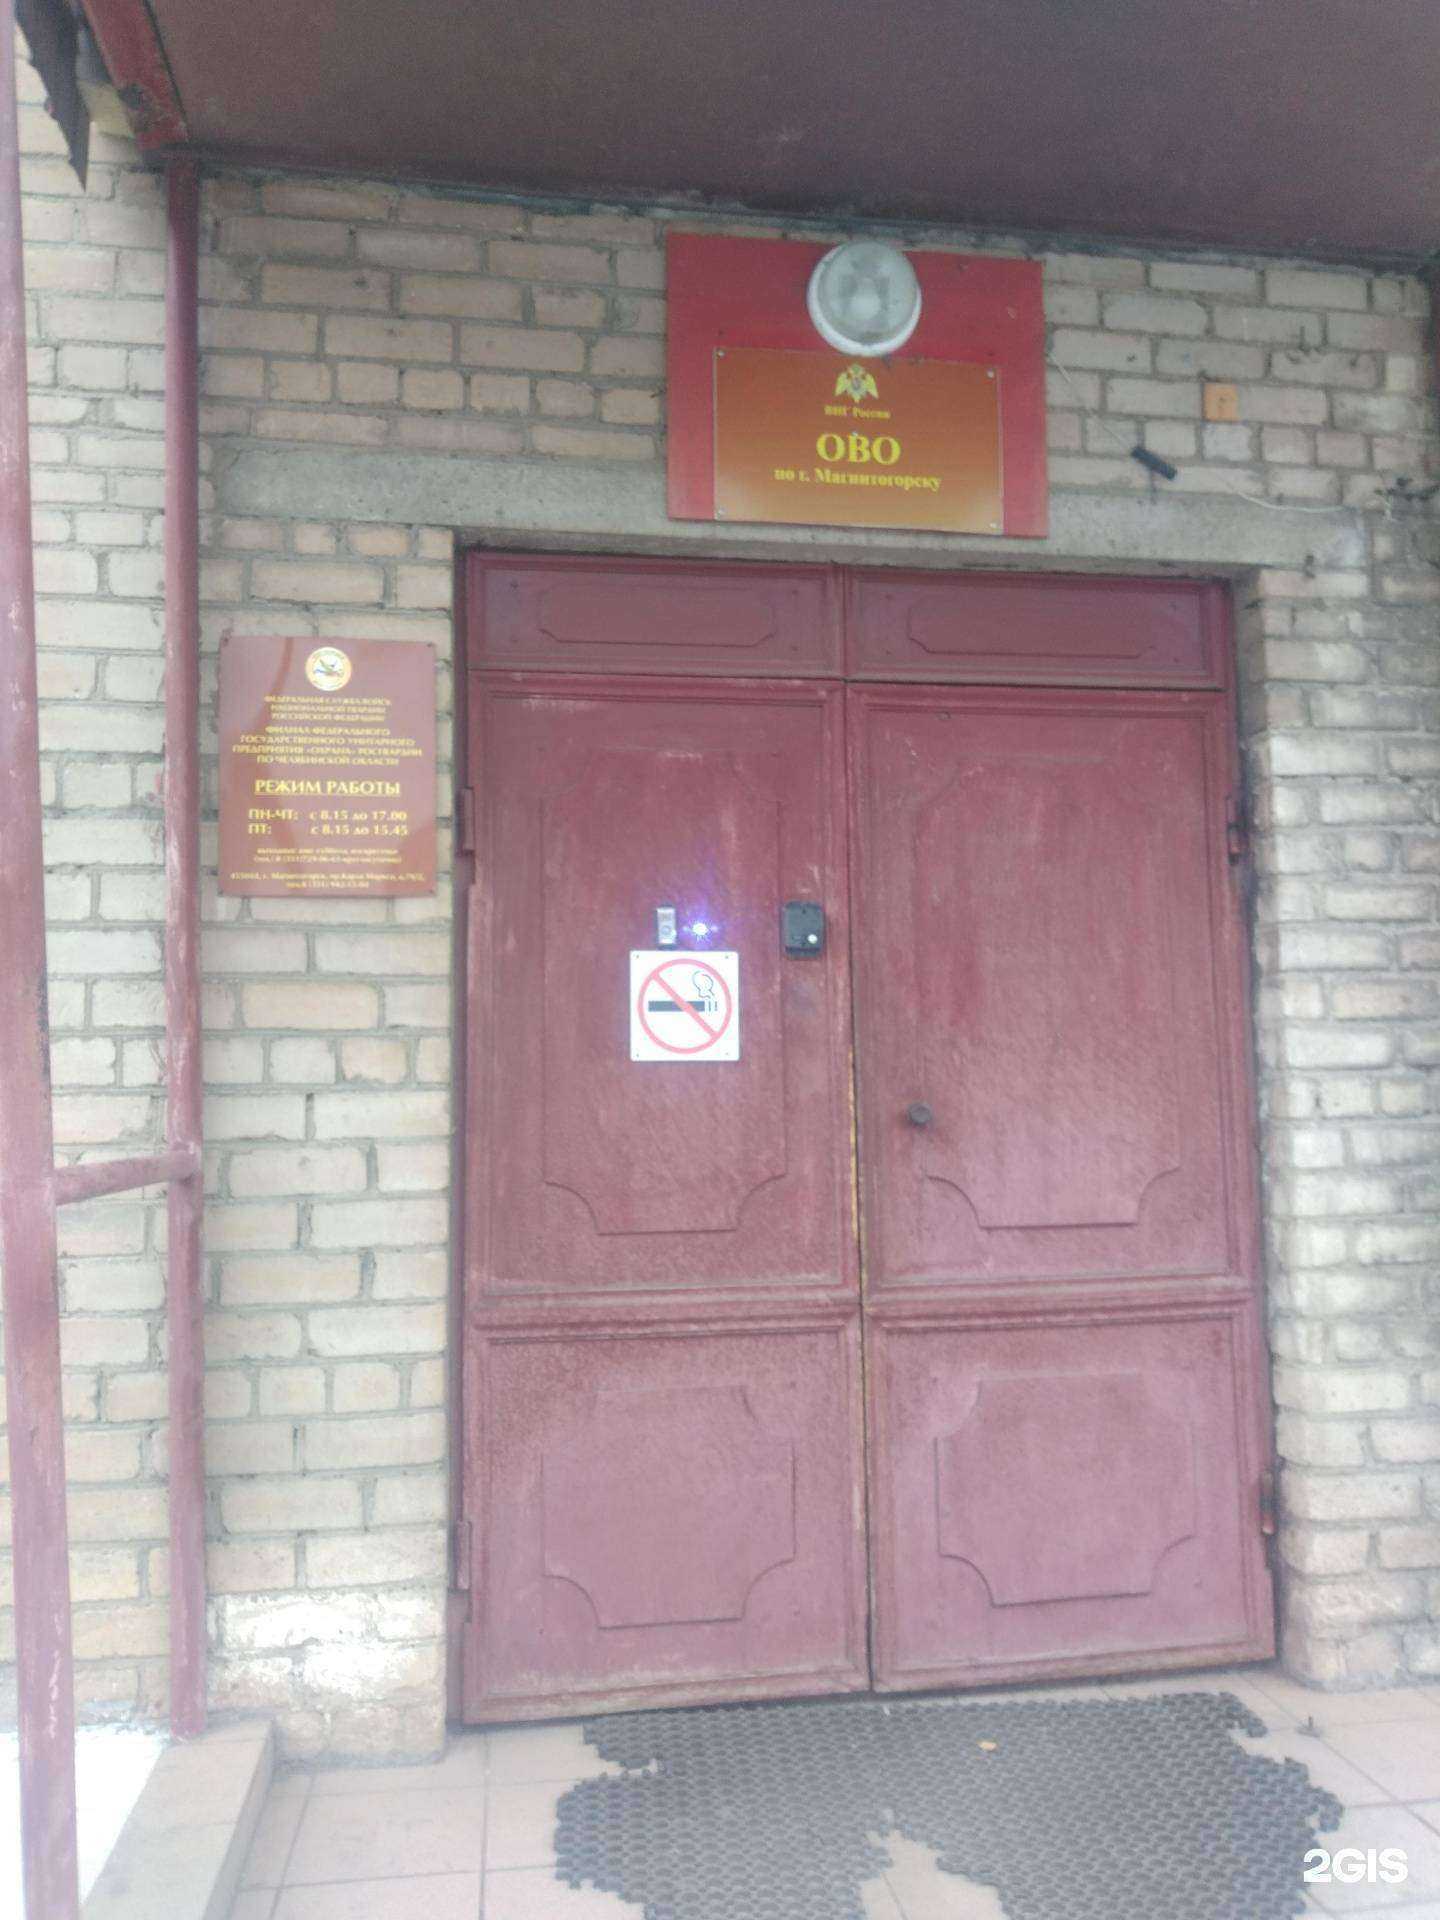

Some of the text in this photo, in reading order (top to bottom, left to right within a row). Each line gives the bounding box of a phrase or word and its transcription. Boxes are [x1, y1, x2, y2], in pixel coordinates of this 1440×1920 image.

[816, 432, 901, 465] ОВО
[774, 468, 942, 492] по г. Магнитогорску
[255, 779, 401, 796] РЕЖИМ РАБОТЫ
[372, 810, 408, 822] 17.00
[248, 822, 272, 835] ПТ:
[374, 824, 409, 837] 15.45
